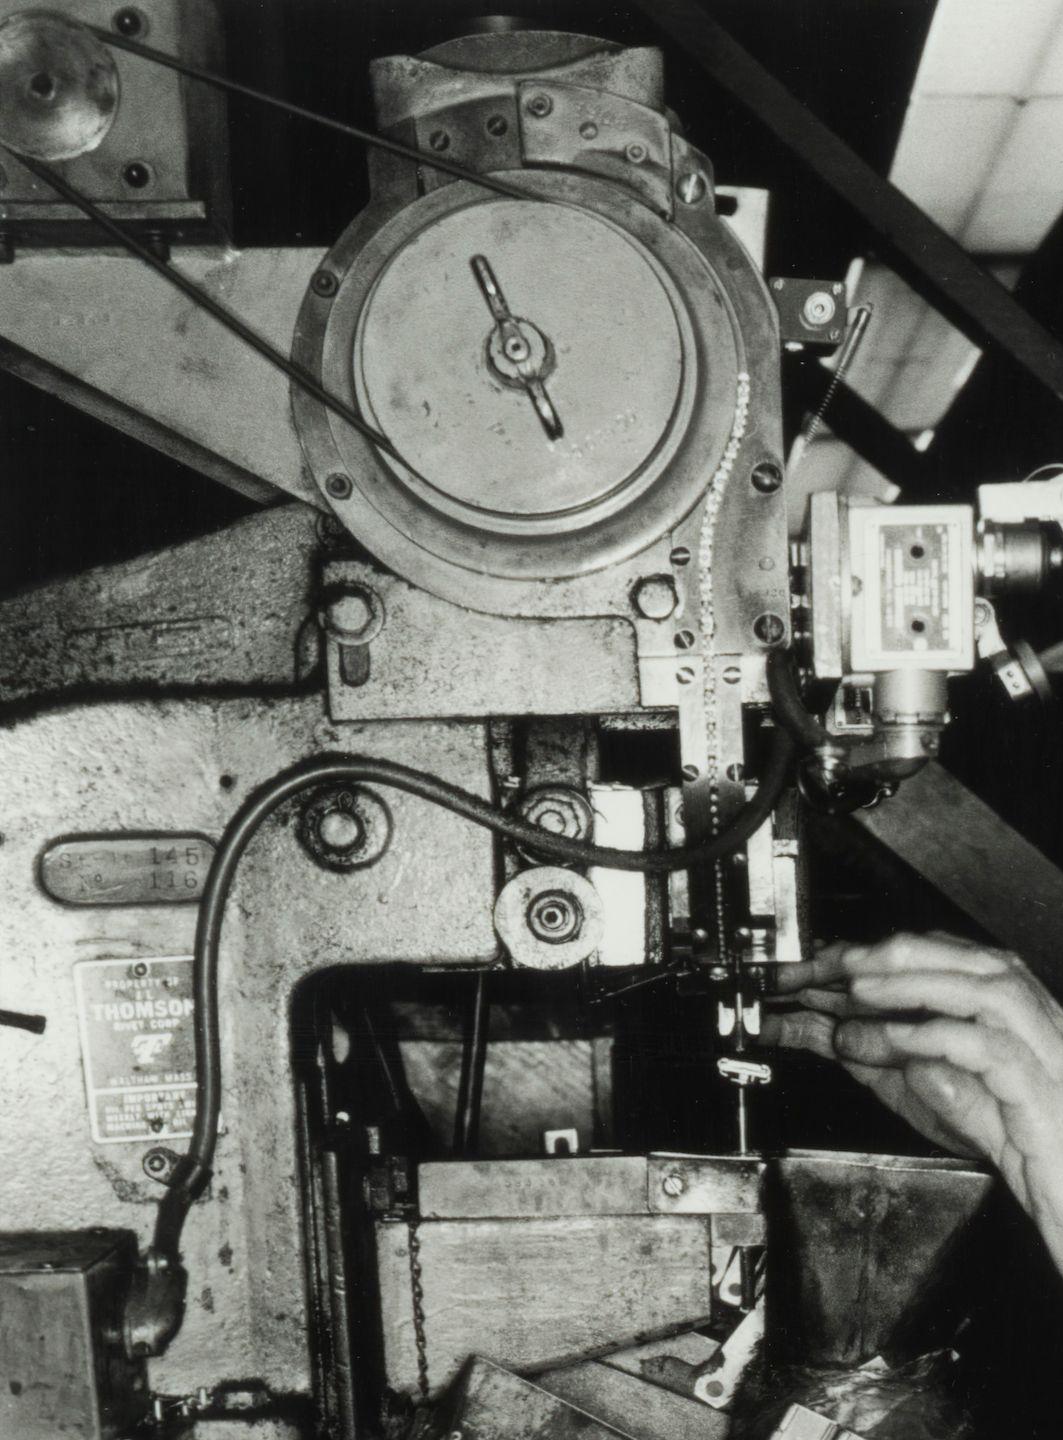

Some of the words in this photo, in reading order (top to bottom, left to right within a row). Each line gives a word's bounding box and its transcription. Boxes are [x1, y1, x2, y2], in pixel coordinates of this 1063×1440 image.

[150, 846, 200, 866] 145
[150, 870, 198, 890] 116
[105, 978, 160, 990] PROPERTY
[92, 999, 195, 1021] THOMSON
[113, 1020, 145, 1032] RIVET
[124, 1090, 185, 1103] IMPORTANT
